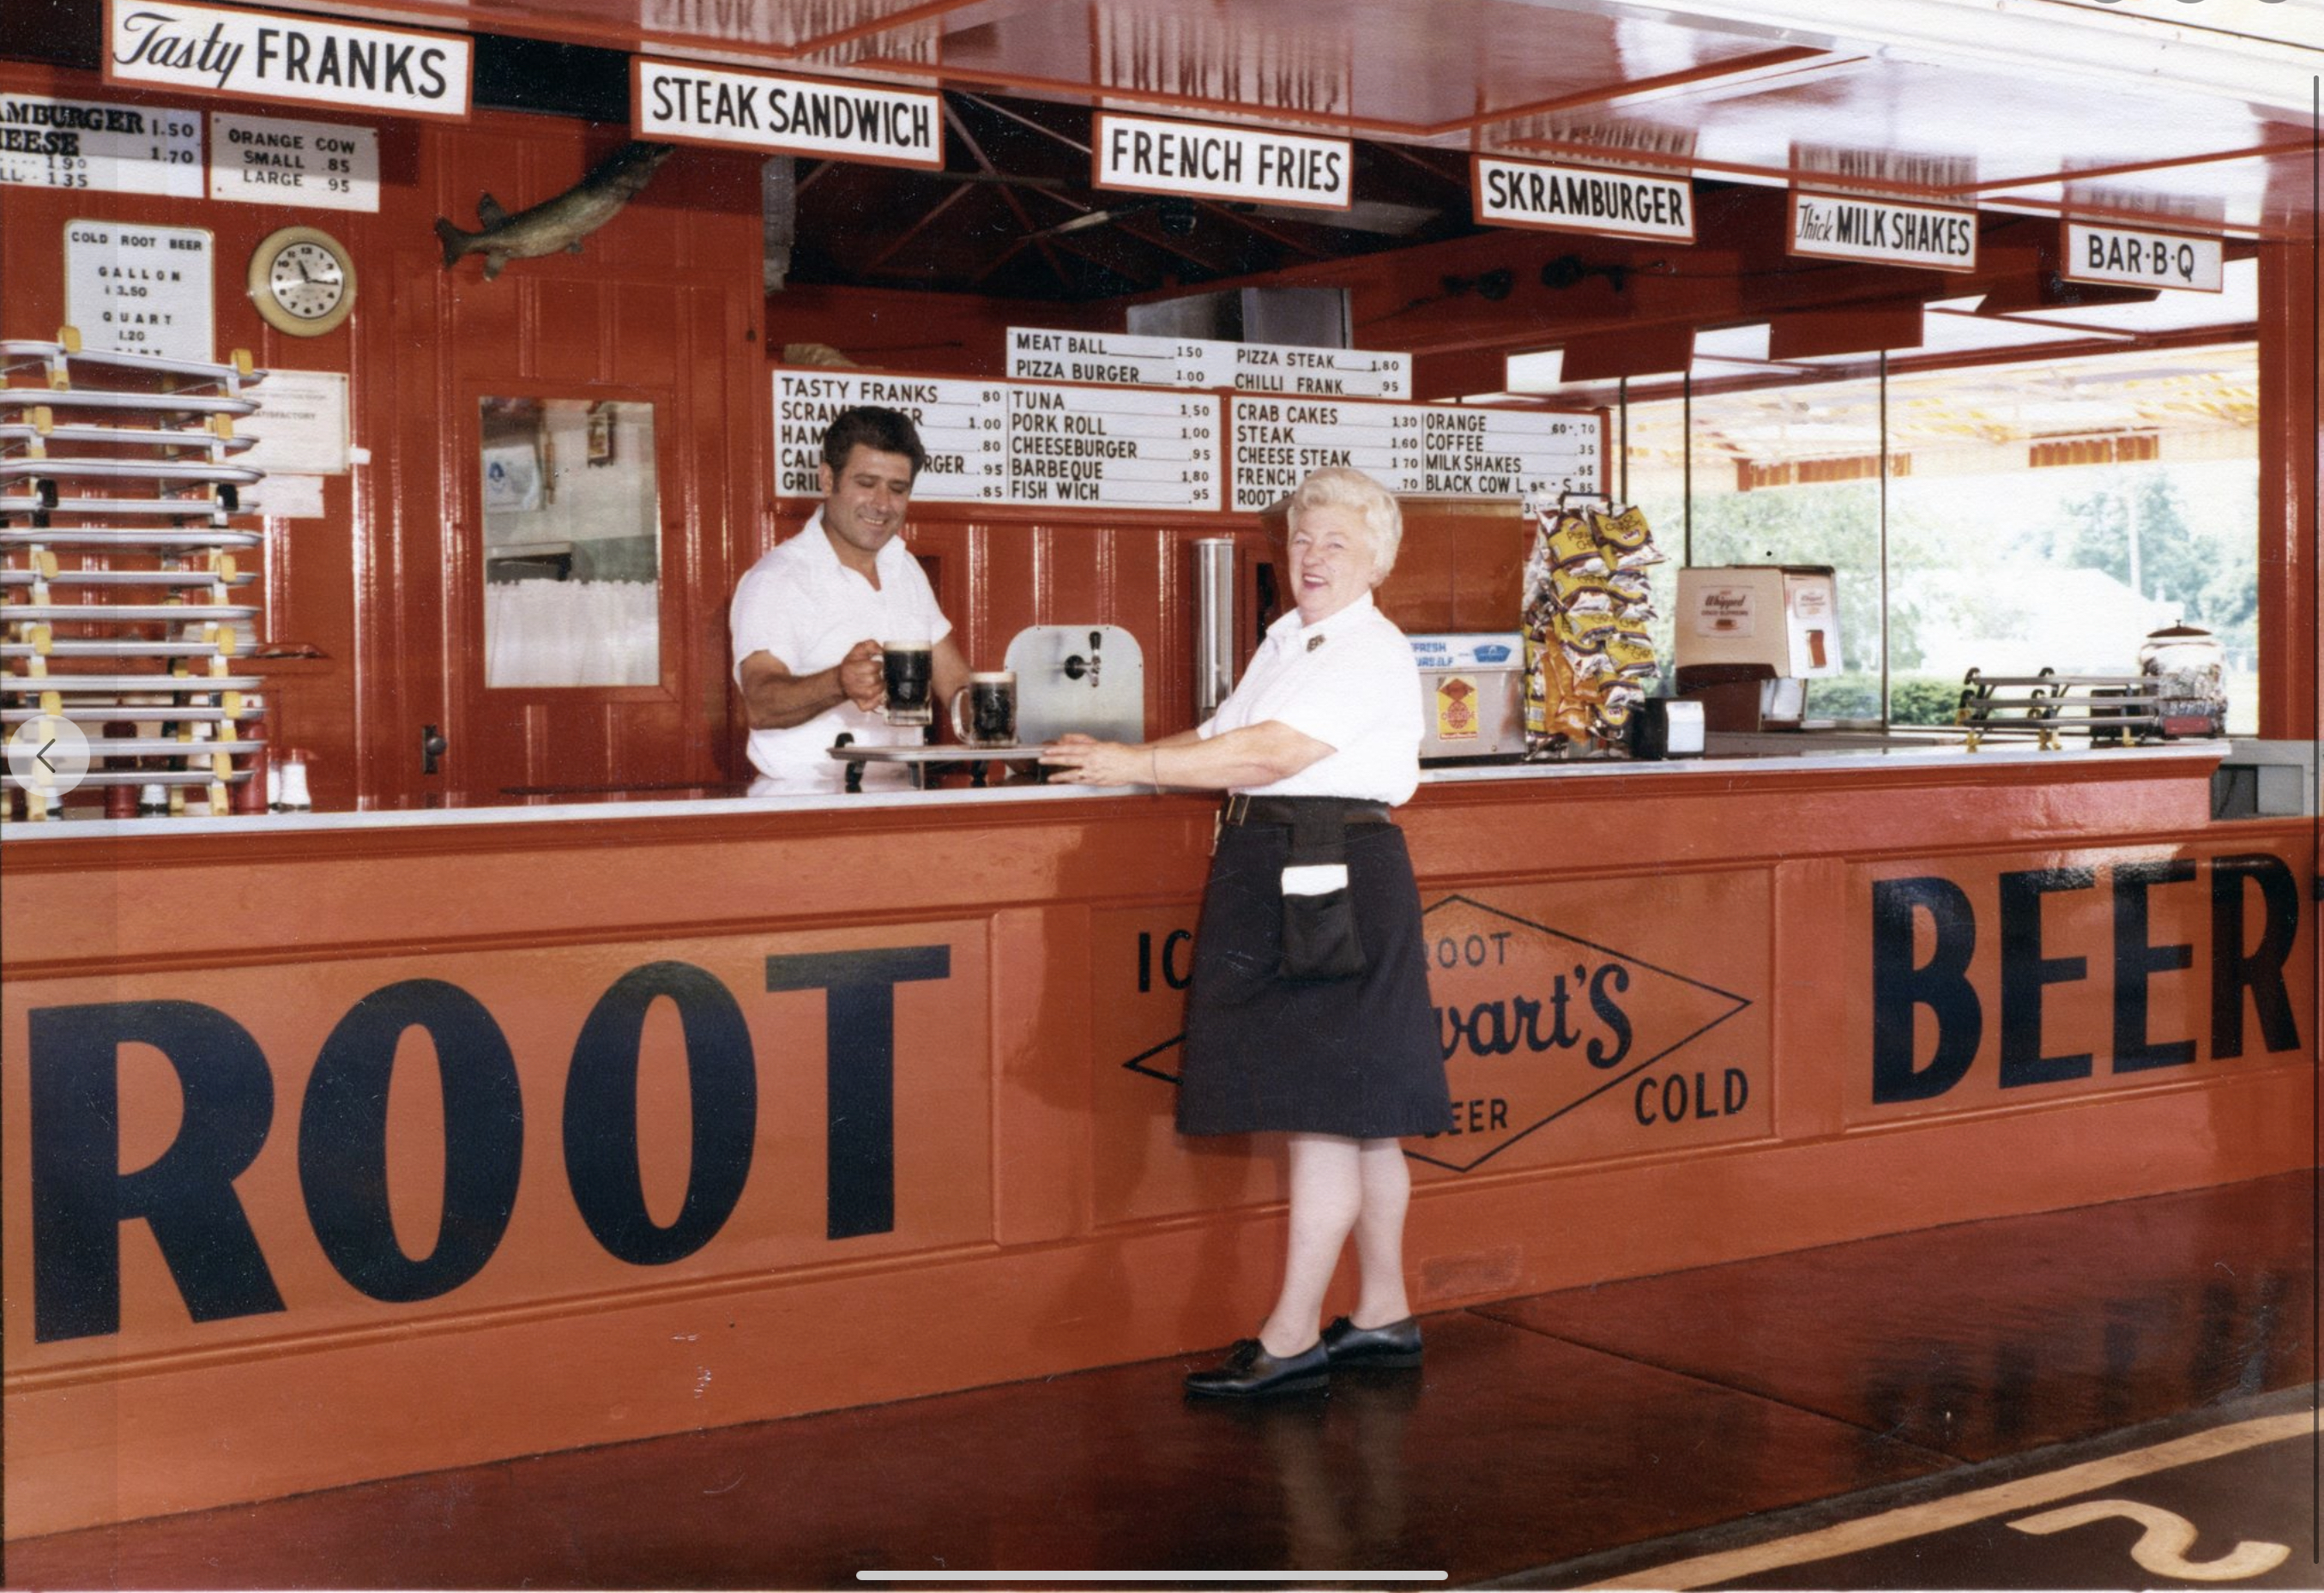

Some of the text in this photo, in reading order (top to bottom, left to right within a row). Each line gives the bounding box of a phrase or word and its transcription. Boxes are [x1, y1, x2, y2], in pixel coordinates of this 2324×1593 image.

[112, 12, 447, 99] Tasty FRANKS
[0, 102, 194, 137] MBURGER 1.50
[653, 75, 930, 148] STEAK SANDWICH
[0, 130, 194, 164] EESE 1.70
[229, 129, 355, 154] ORANGE COW
[244, 150, 305, 169] SMALL
[1112, 129, 1341, 192] FRENCH FRIES
[244, 170, 304, 187] LARGE
[1488, 169, 1685, 226] SKRAMBURGER
[1796, 203, 1970, 256] Thick MILK SHAKES
[71, 232, 202, 251] COLD ROOT BEER
[99, 266, 181, 281] GALLON
[102, 311, 172, 325] QUART
[1017, 333, 1062, 353] MEAT
[1068, 337, 1107, 354] BALL
[1016, 359, 1065, 378] PIZZA
[1072, 363, 1139, 383] BURGER
[1237, 349, 1399, 371] PIZZA STEAK 1.80
[782, 377, 849, 399] TASTY
[860, 383, 937, 403] FRANKS
[1234, 373, 1283, 391] CHILLI
[1297, 377, 1343, 395] FRANK
[1013, 391, 1210, 419] TUNA 1.50
[1237, 403, 1279, 423] CRAB
[1287, 407, 1338, 425] CAKES
[969, 417, 1001, 430] 1.00
[1011, 413, 1210, 439] PORK ROLL 1.00
[1426, 413, 1487, 432] ORANGE
[1237, 425, 1295, 444] STEAK
[1426, 433, 1484, 452] COFFEE
[1011, 437, 1137, 459] CHEESEBURGER
[1237, 447, 1295, 466] CHEESE
[1300, 450, 1352, 468] STEAK
[921, 456, 964, 474] RGER
[1011, 459, 1209, 484] BARBEQUE 1.80
[1426, 455, 1461, 472] MILK
[1464, 456, 1521, 474] SHAKES
[1237, 468, 1296, 486] FRENCH
[1426, 475, 1473, 492] BLACK
[1479, 477, 1510, 493] COW
[1011, 480, 1047, 499] FISH
[1057, 482, 1099, 501] WICH
[1237, 489, 1276, 506] ROOT
[1138, 929, 1191, 993] IC
[1872, 853, 2302, 1106] BEER
[1635, 1067, 1749, 1125] COLD
[1425, 1098, 1508, 1137] EER
[29, 944, 951, 1344] ROOT
